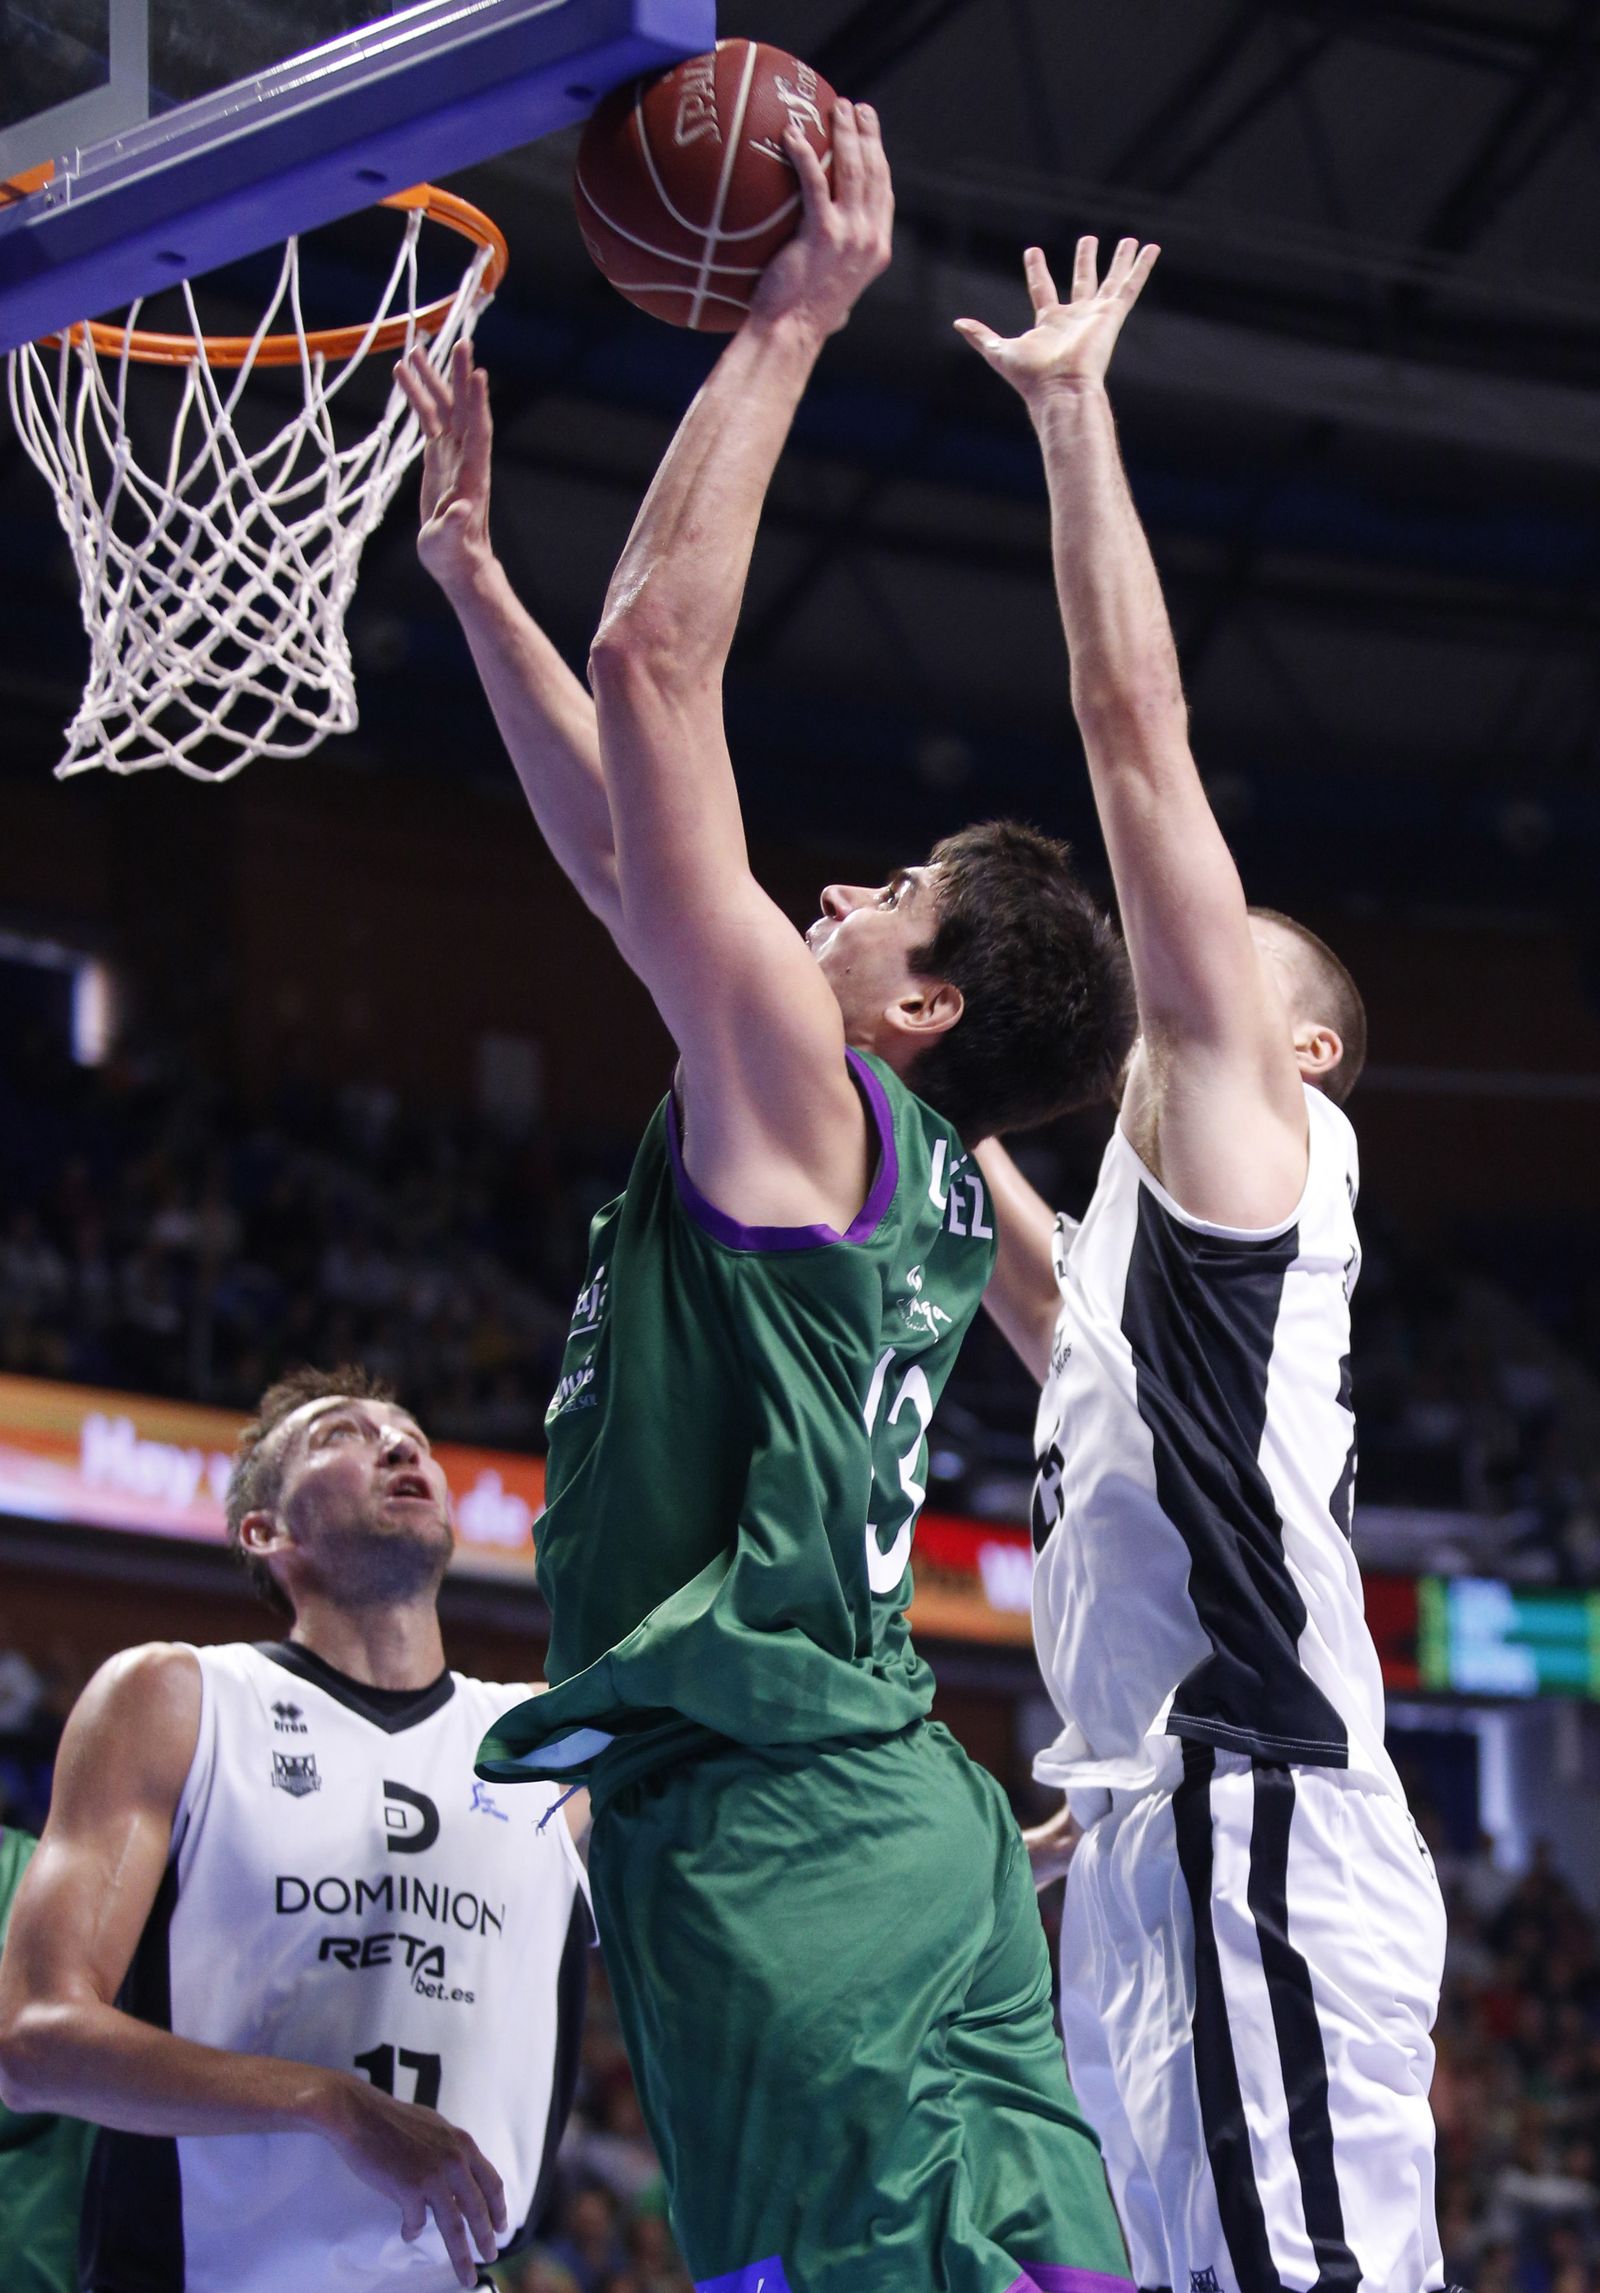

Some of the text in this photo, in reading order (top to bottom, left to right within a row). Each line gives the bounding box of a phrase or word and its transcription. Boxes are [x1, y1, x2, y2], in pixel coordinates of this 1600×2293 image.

[275, 1875, 506, 1939] DOMINION
[318, 1932, 445, 1986] RETA
[414, 1974, 476, 2005] bet.es
[353, 2042, 442, 2111] 17
